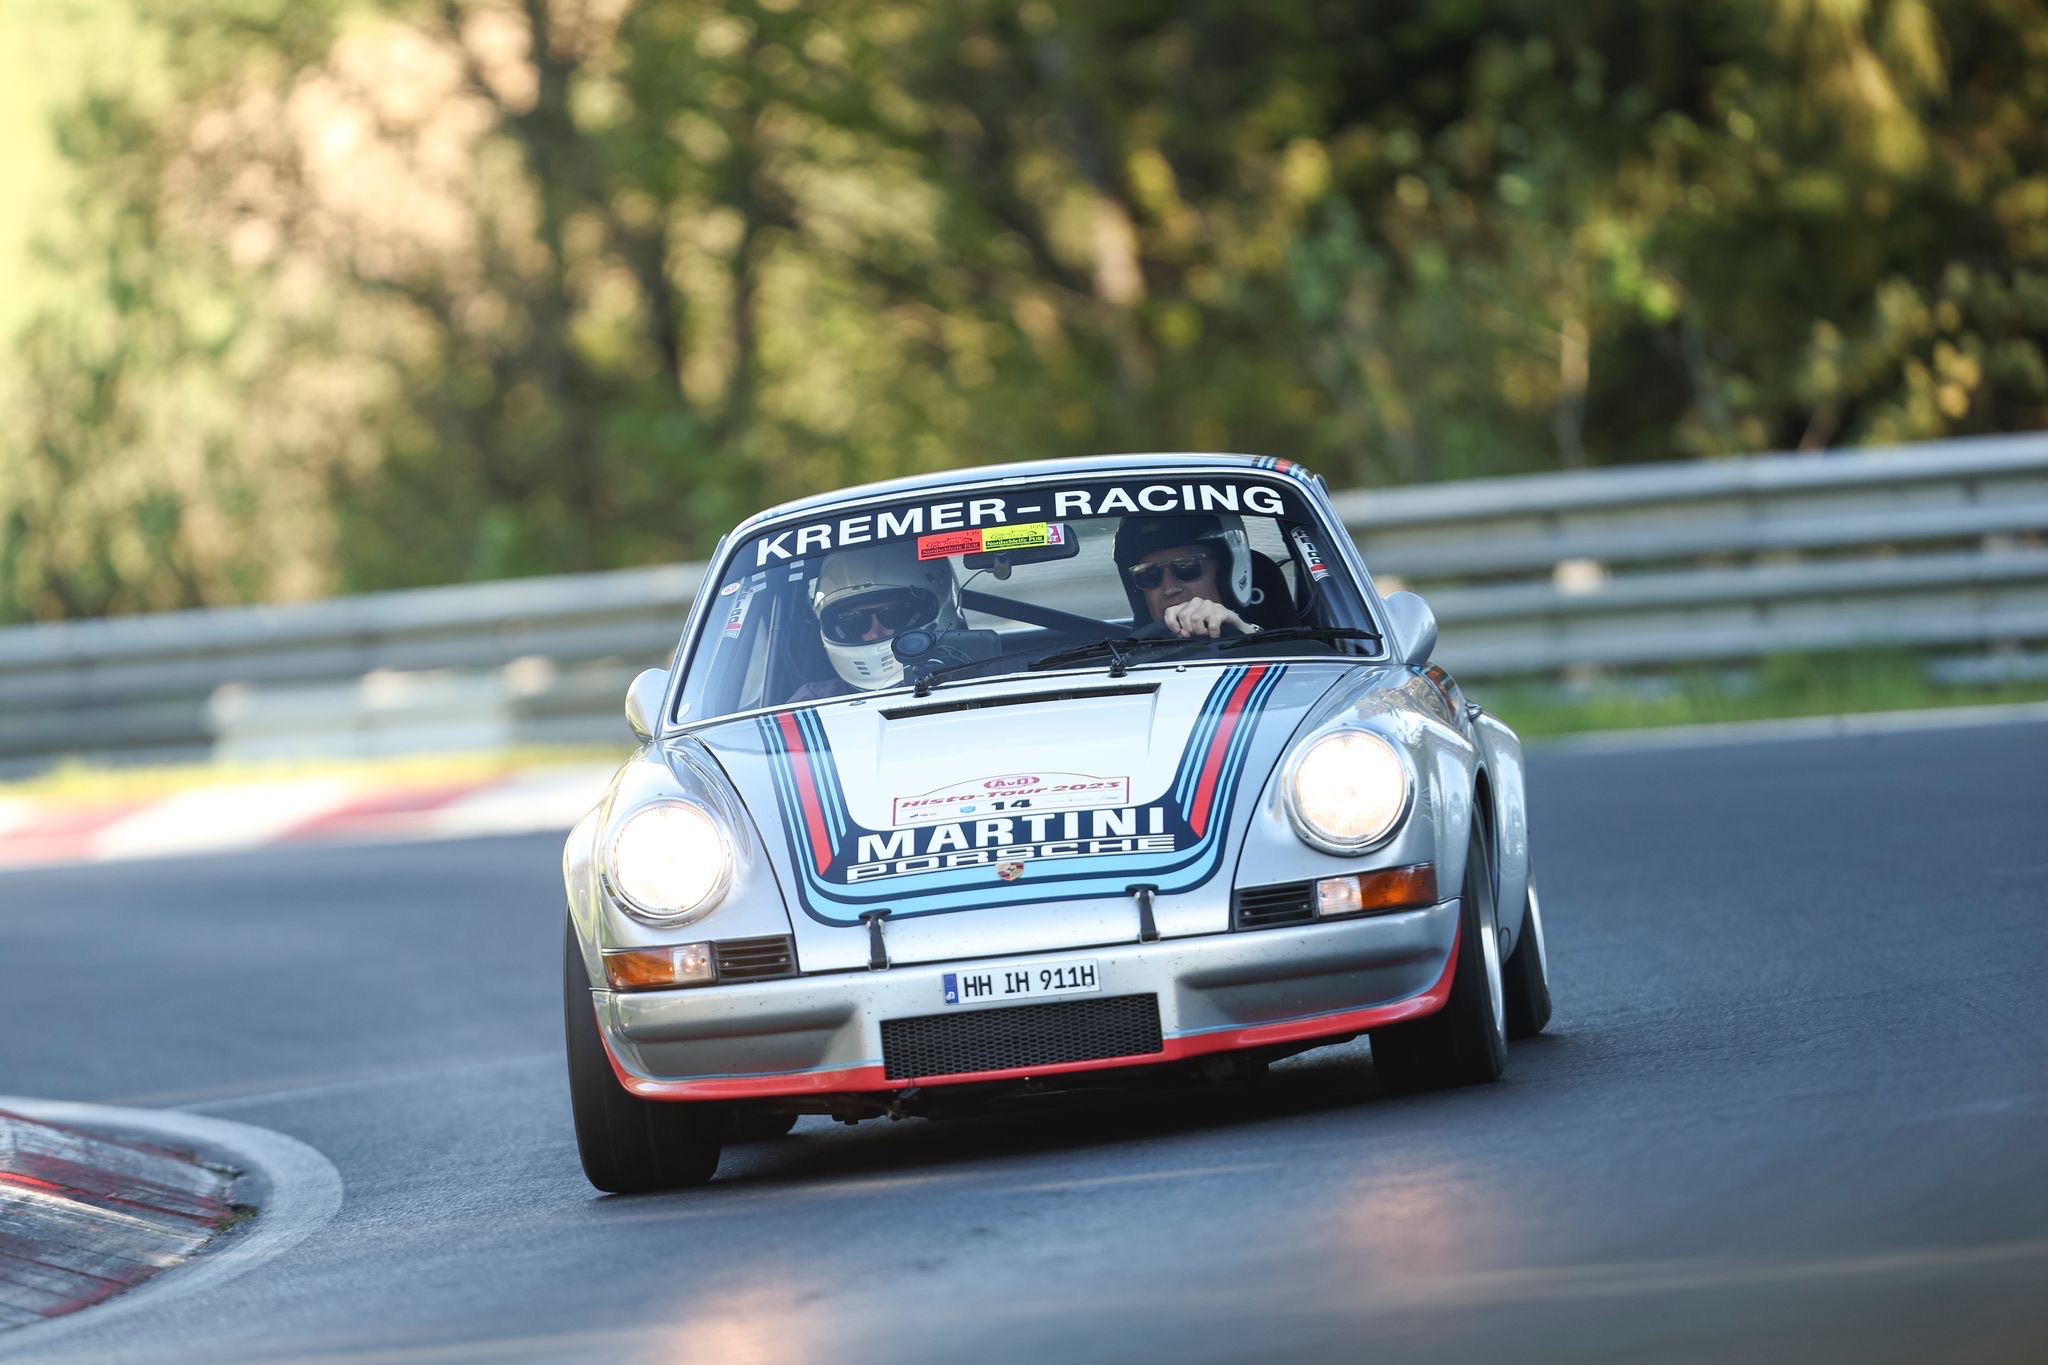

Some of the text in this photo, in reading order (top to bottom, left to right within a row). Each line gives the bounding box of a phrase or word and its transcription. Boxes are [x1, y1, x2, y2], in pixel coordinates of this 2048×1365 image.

[994, 778, 1029, 787] AvD
[1051, 781, 1121, 792] 2023
[991, 798, 1032, 811] 14
[857, 806, 1164, 863] MARTINI
[847, 834, 1175, 884] PORSCHE
[963, 964, 1096, 998] HH IH 911H
